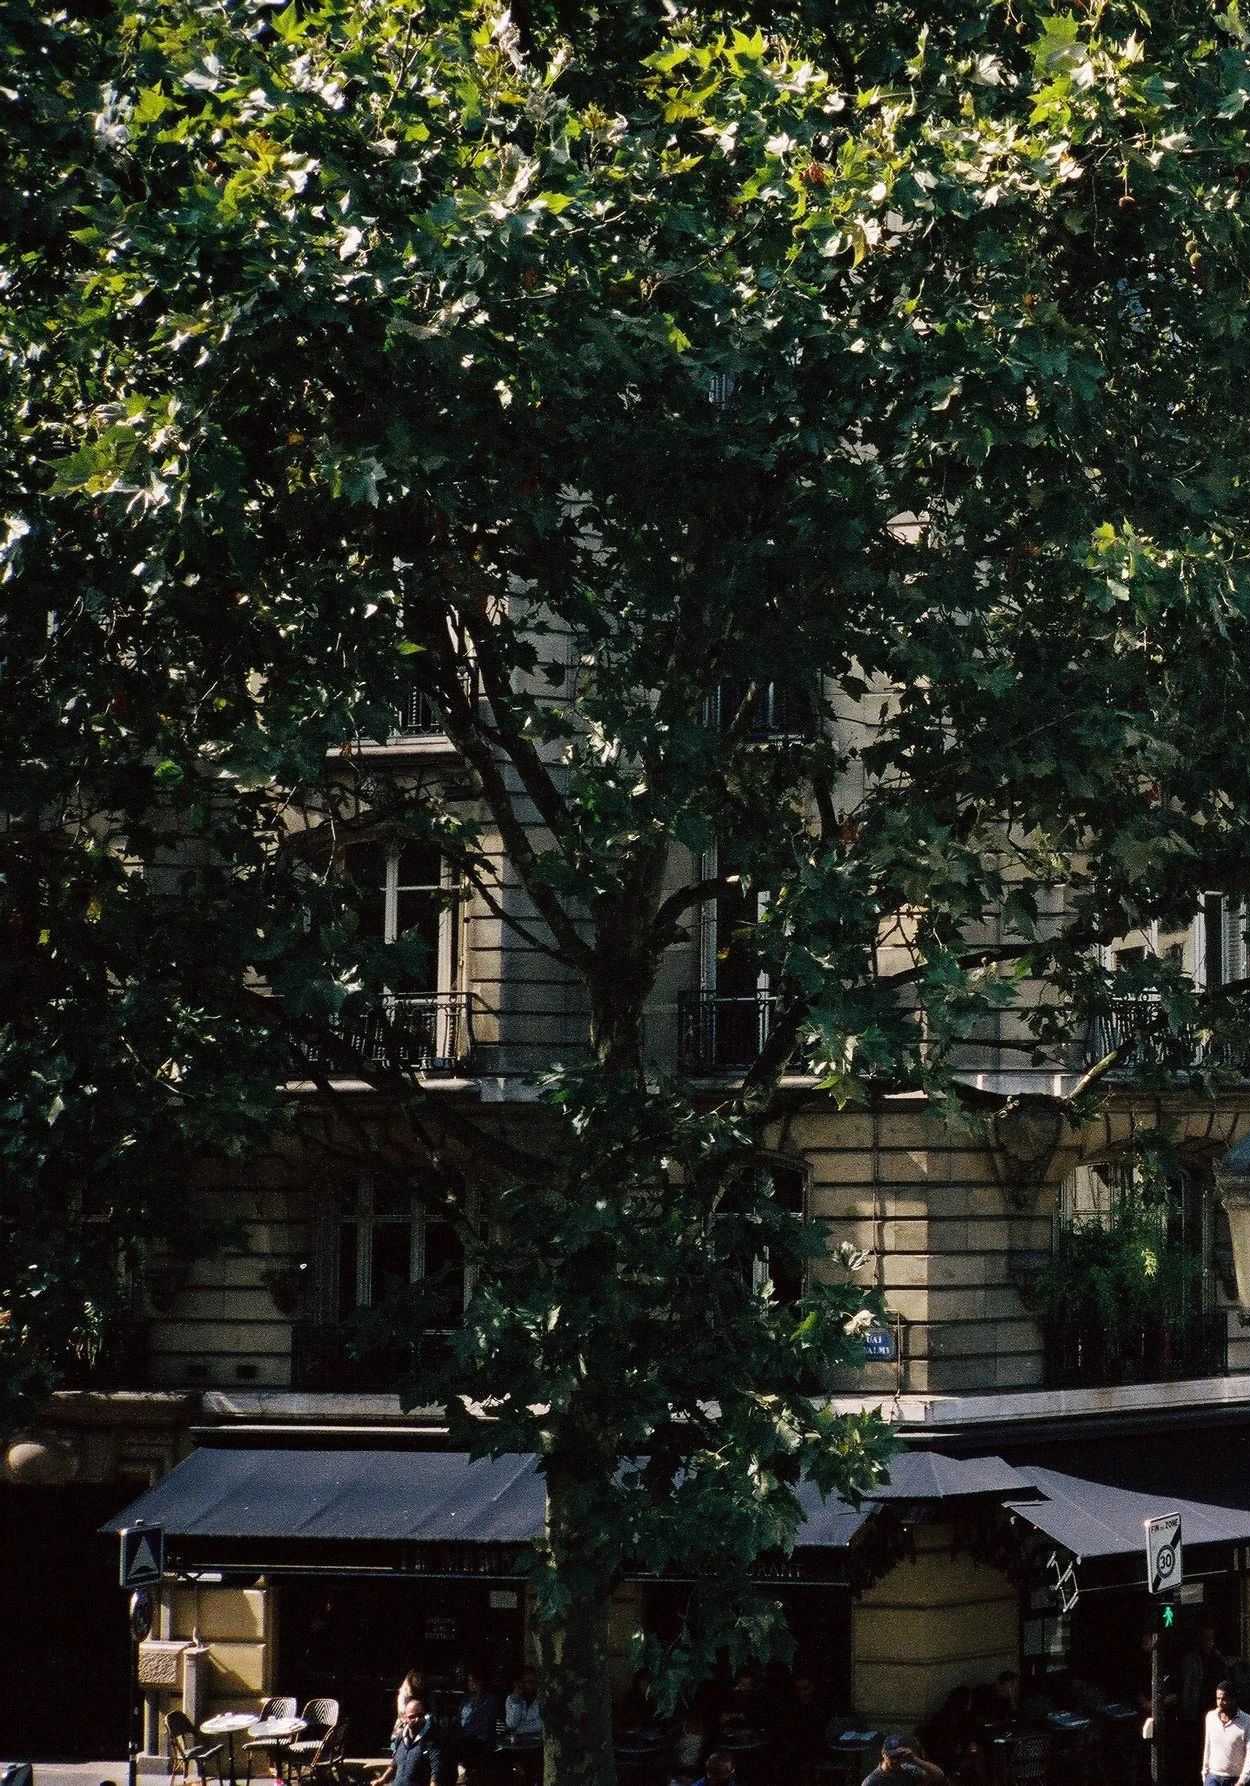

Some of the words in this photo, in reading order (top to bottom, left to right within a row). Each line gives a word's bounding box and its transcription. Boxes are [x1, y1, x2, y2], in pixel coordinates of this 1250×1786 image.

[865, 1336, 882, 1344] UAI
[1165, 1518, 1179, 1530] ZONE
[1160, 1553, 1172, 1569] 30
